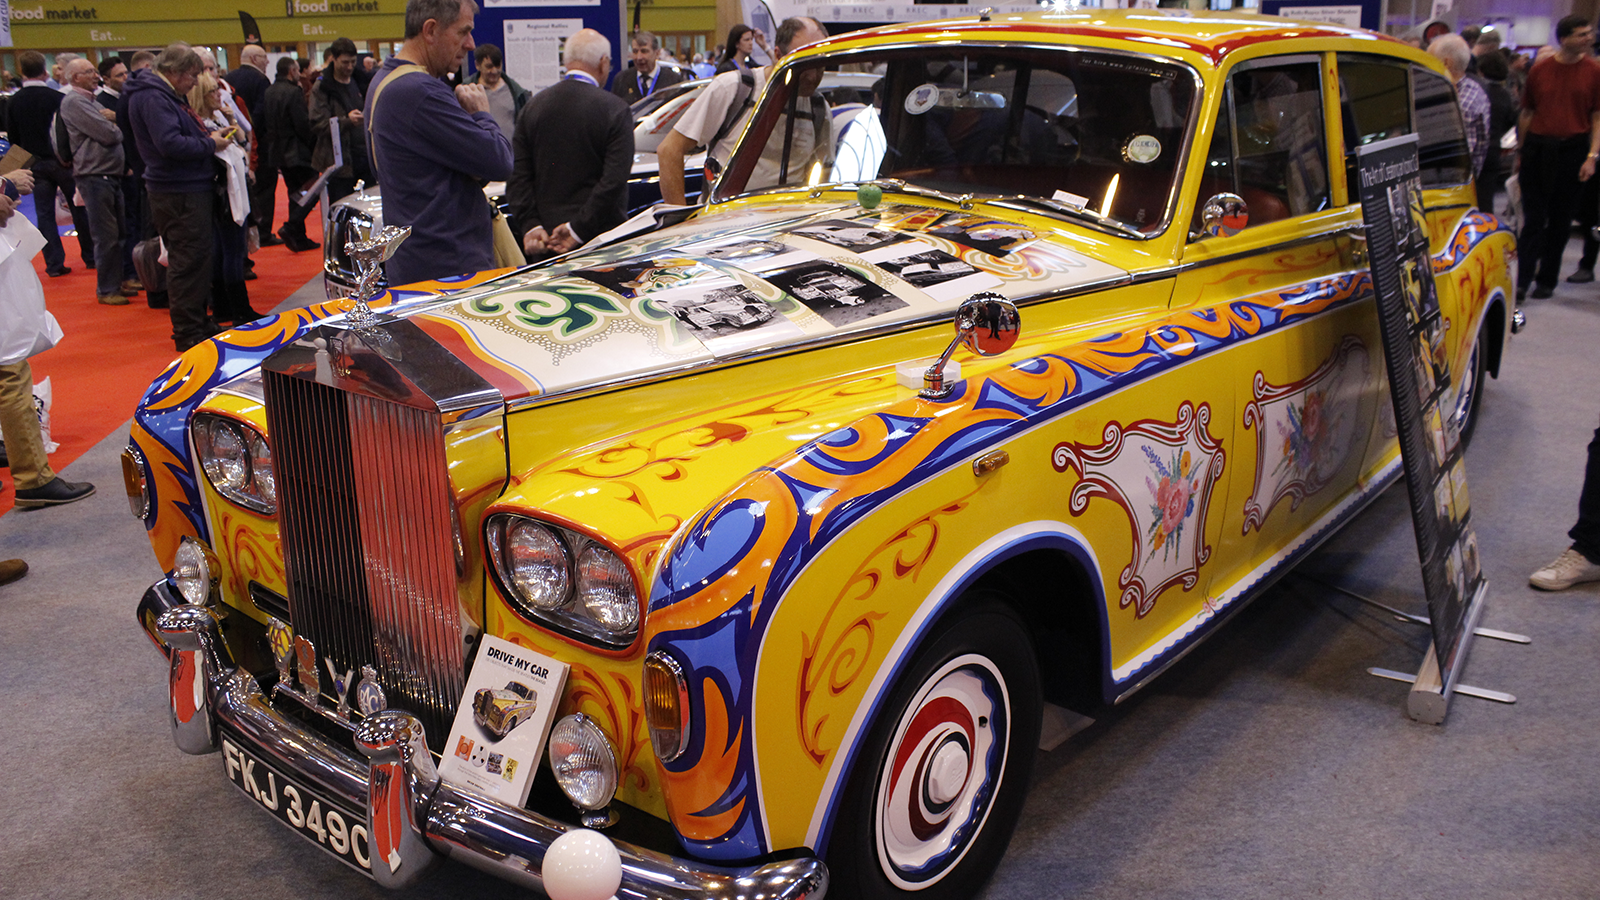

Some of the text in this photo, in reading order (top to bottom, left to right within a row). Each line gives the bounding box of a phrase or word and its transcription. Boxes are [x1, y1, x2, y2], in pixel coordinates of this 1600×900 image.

[9, 6, 97, 20] food market
[295, 0, 328, 13] food
[331, 0, 378, 12] market
[487, 646, 549, 679] DRIVE MY CAR
[223, 740, 279, 811] FKJ
